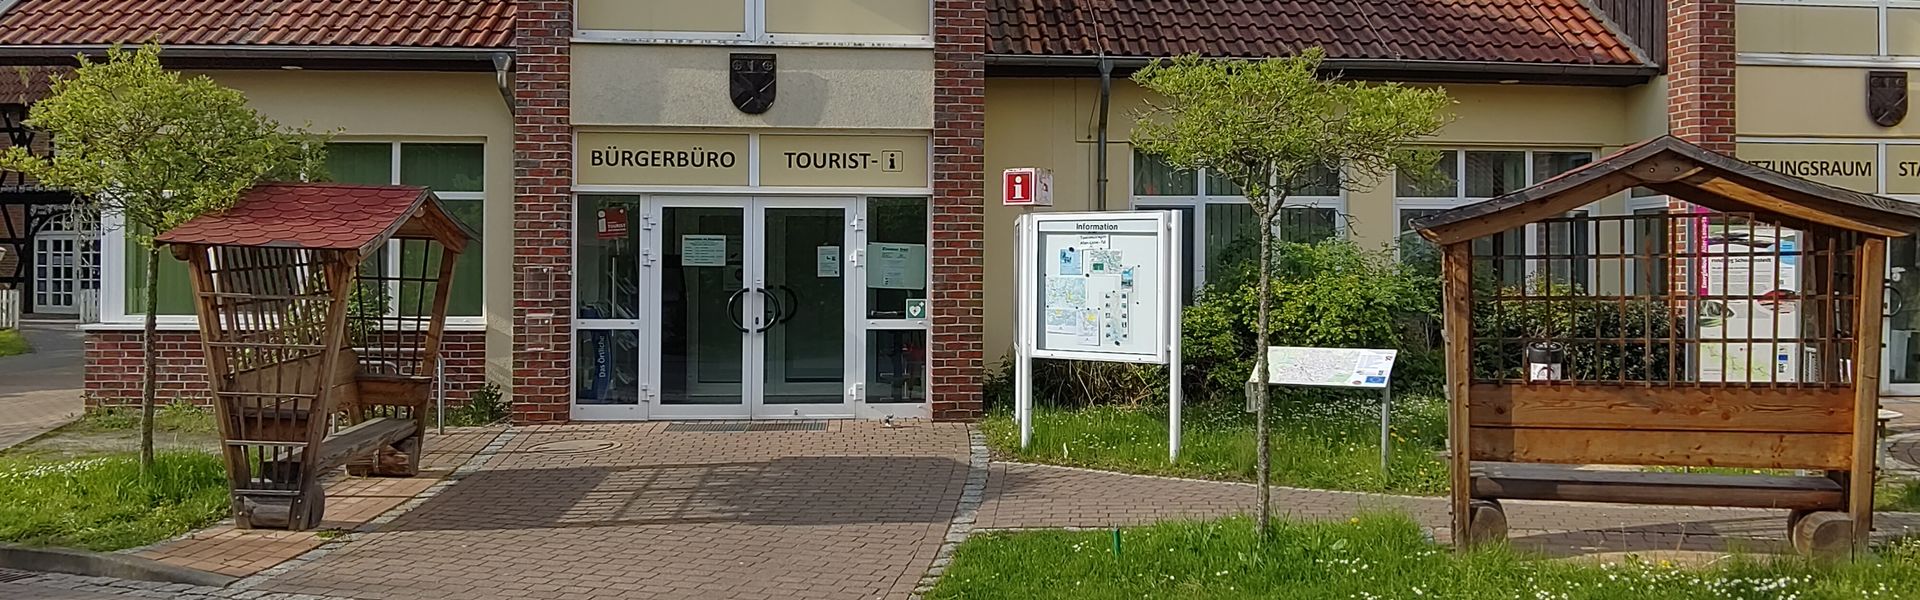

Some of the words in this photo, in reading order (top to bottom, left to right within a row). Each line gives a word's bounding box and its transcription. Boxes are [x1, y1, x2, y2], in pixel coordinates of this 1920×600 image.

[591, 146, 736, 168] BÜRGERBÜRO
[783, 152, 878, 169] TOURIST-
[1076, 222, 1119, 231] Information
[598, 365, 606, 378] Das
